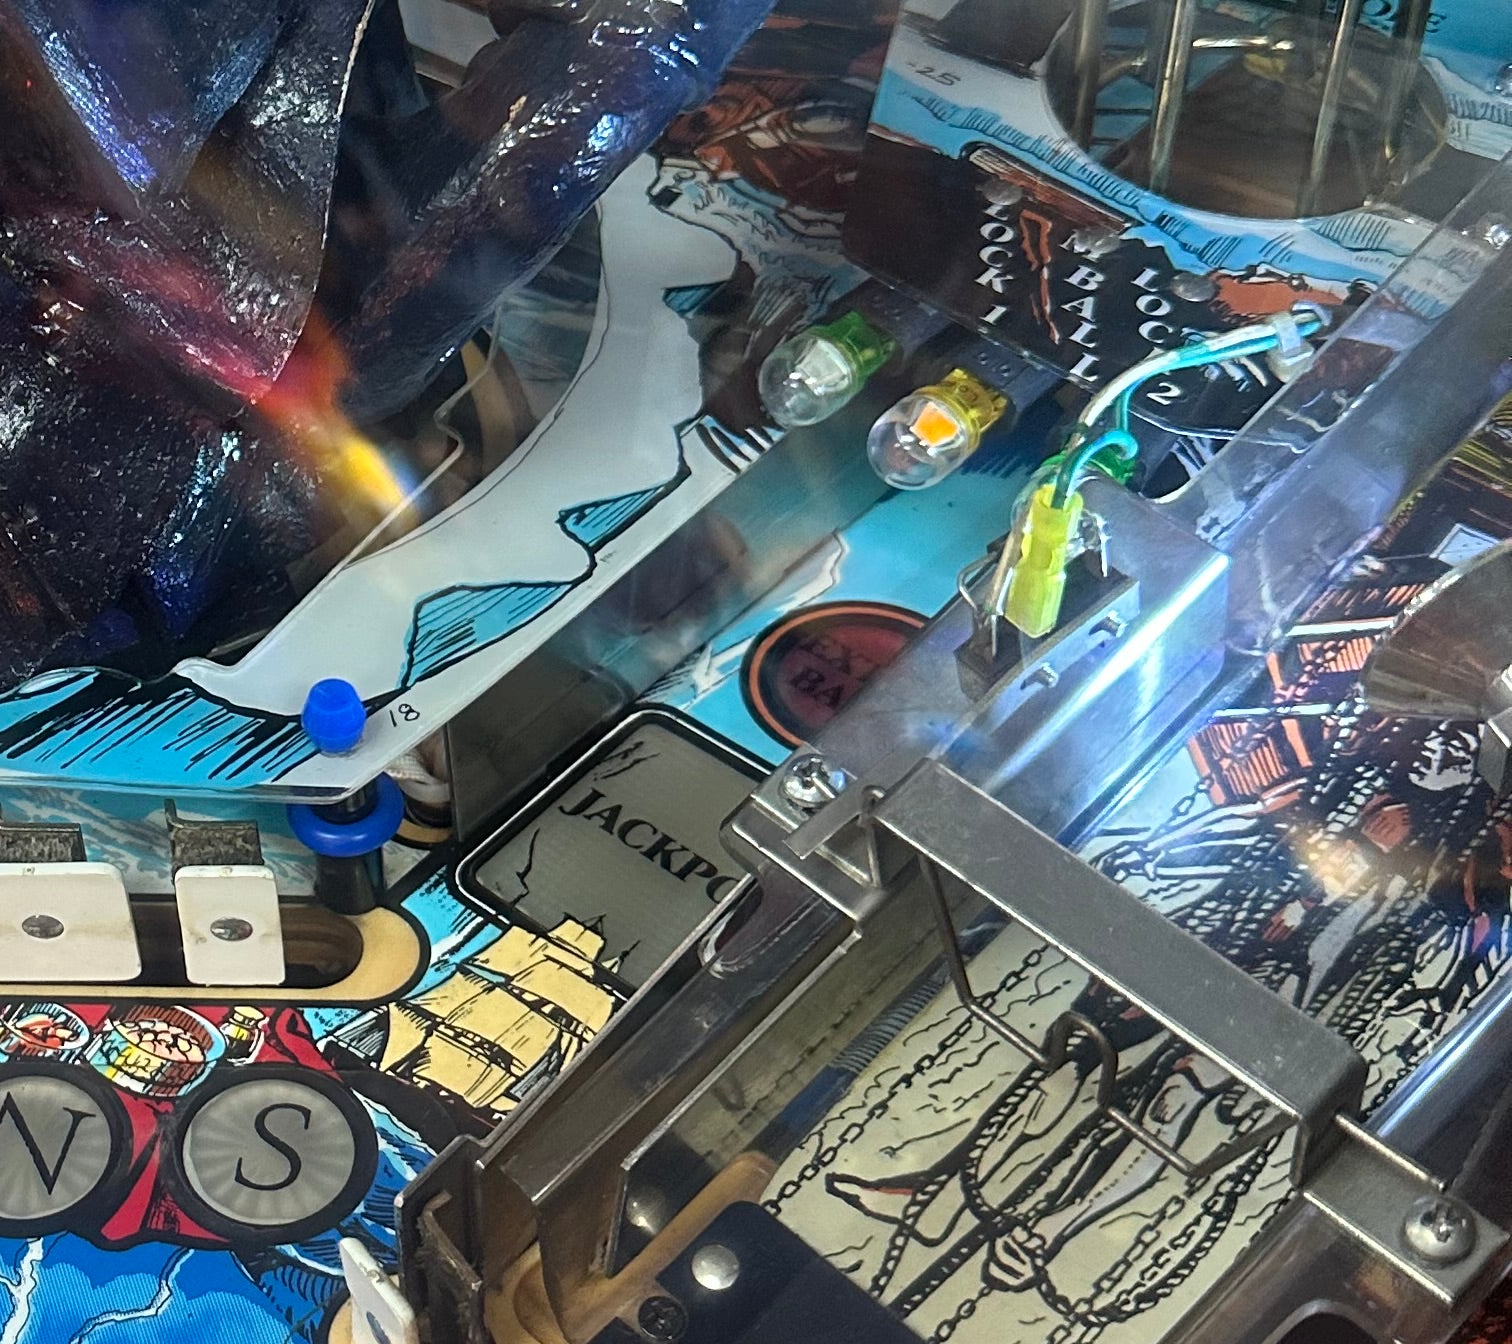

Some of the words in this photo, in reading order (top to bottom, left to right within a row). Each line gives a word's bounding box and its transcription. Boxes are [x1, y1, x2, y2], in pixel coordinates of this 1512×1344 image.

[1146, 382, 1181, 405] 2
[790, 667, 845, 710] BA
[558, 787, 742, 904] JACKPO
[234, 1101, 312, 1191] S
